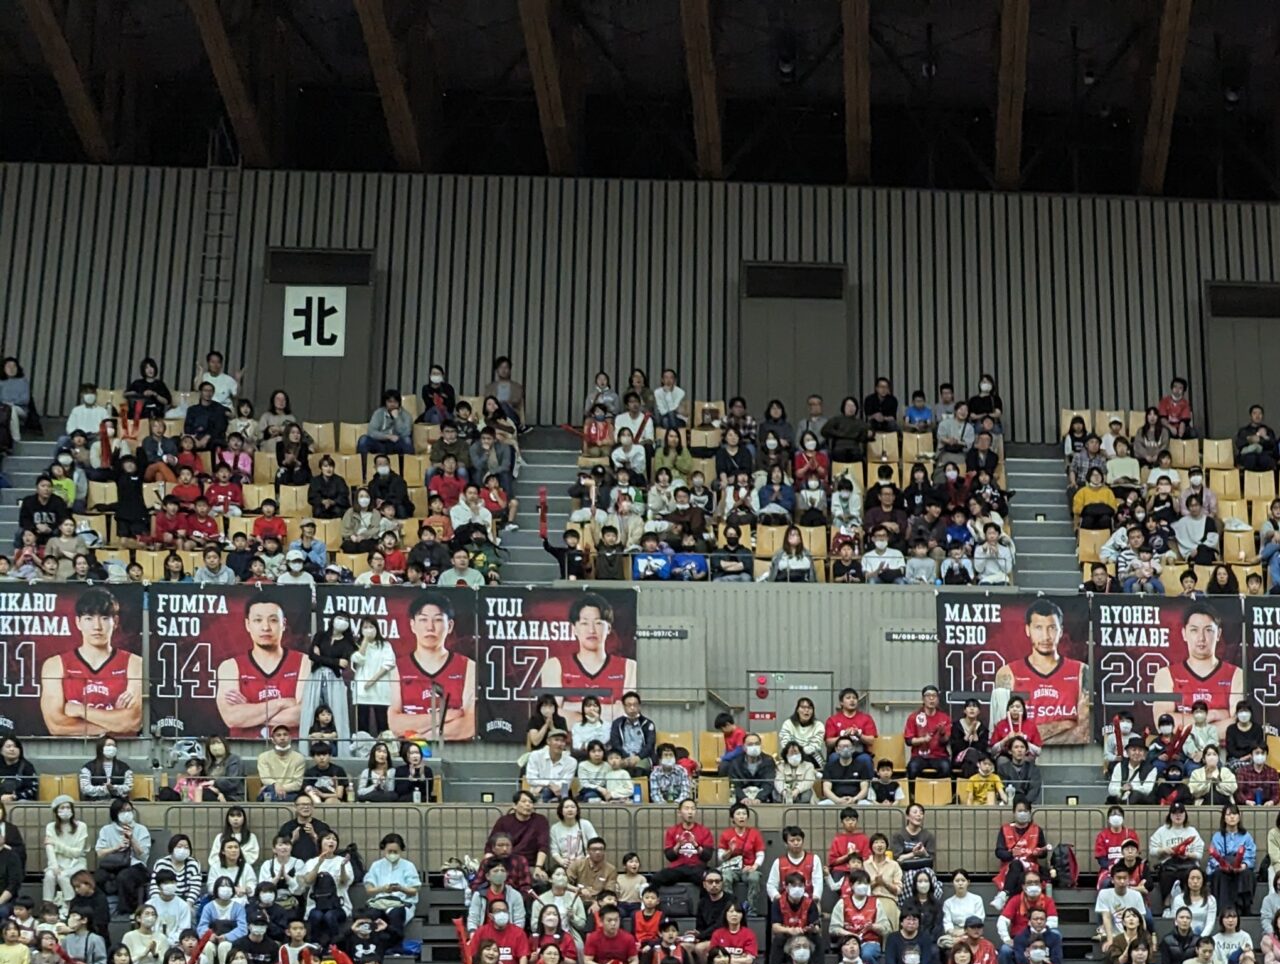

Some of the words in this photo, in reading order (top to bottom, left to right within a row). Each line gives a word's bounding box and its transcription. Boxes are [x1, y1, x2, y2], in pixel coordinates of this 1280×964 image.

[292, 296, 338, 346] 北
[157, 594, 229, 614] FUMIYA
[485, 597, 523, 617] YUJI
[944, 603, 1001, 623] MAXIE
[1100, 605, 1160, 625] RYOHEI
[157, 616, 200, 637] SATO
[485, 620, 577, 641] TAKAHASHI
[944, 625, 986, 645] ESHO
[1100, 627, 1170, 648] KAWABE
[157, 642, 217, 699] 14
[485, 645, 550, 701] 17
[945, 650, 1006, 705] 18
[1101, 652, 1170, 706] 28
[1037, 705, 1078, 718] SCALA
